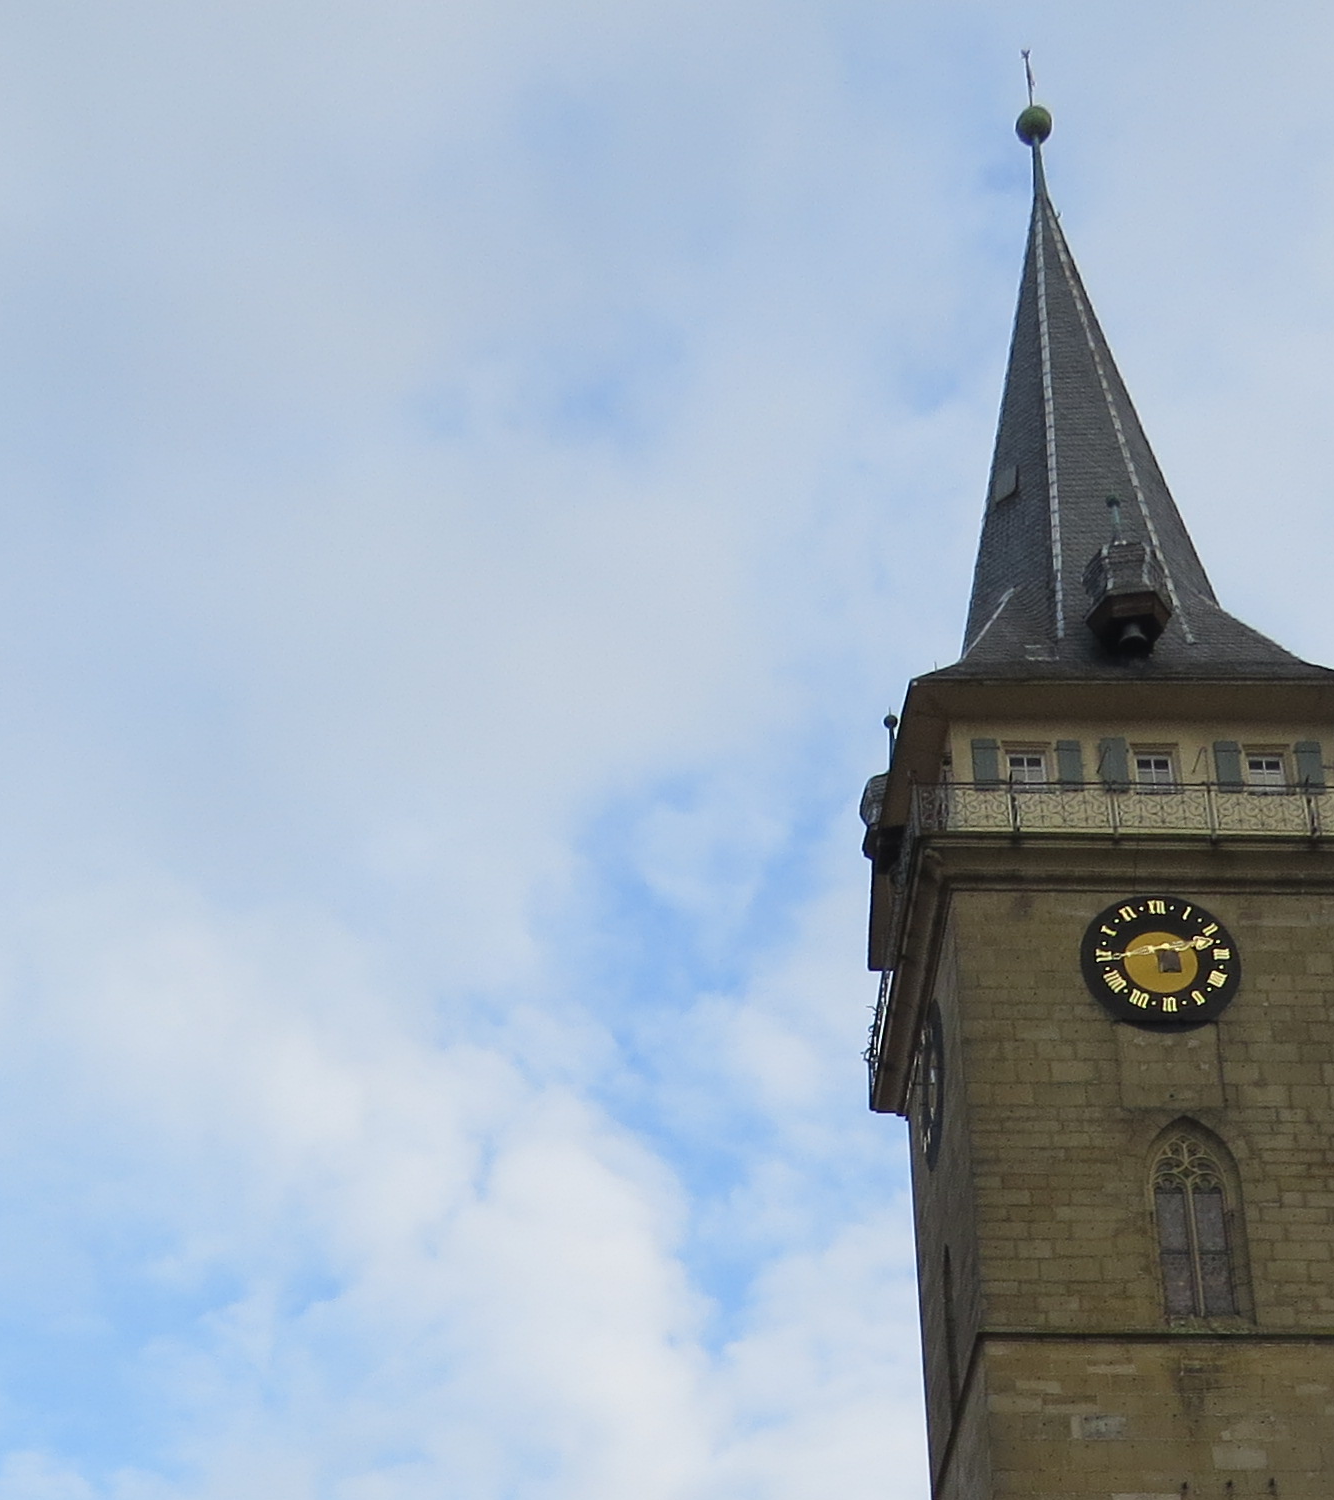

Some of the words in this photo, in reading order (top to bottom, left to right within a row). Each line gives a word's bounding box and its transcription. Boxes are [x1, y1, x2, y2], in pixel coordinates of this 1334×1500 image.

[1118, 905, 1138, 921] XI
[1147, 900, 1166, 915] XII
[1182, 906, 1192, 920] I
[1202, 923, 1219, 936] II
[1213, 948, 1230, 960] III
[1103, 969, 1127, 993] VIII
[1128, 988, 1150, 1009] VII
[1162, 996, 1178, 1012] VI
[1191, 990, 1206, 1006] V
